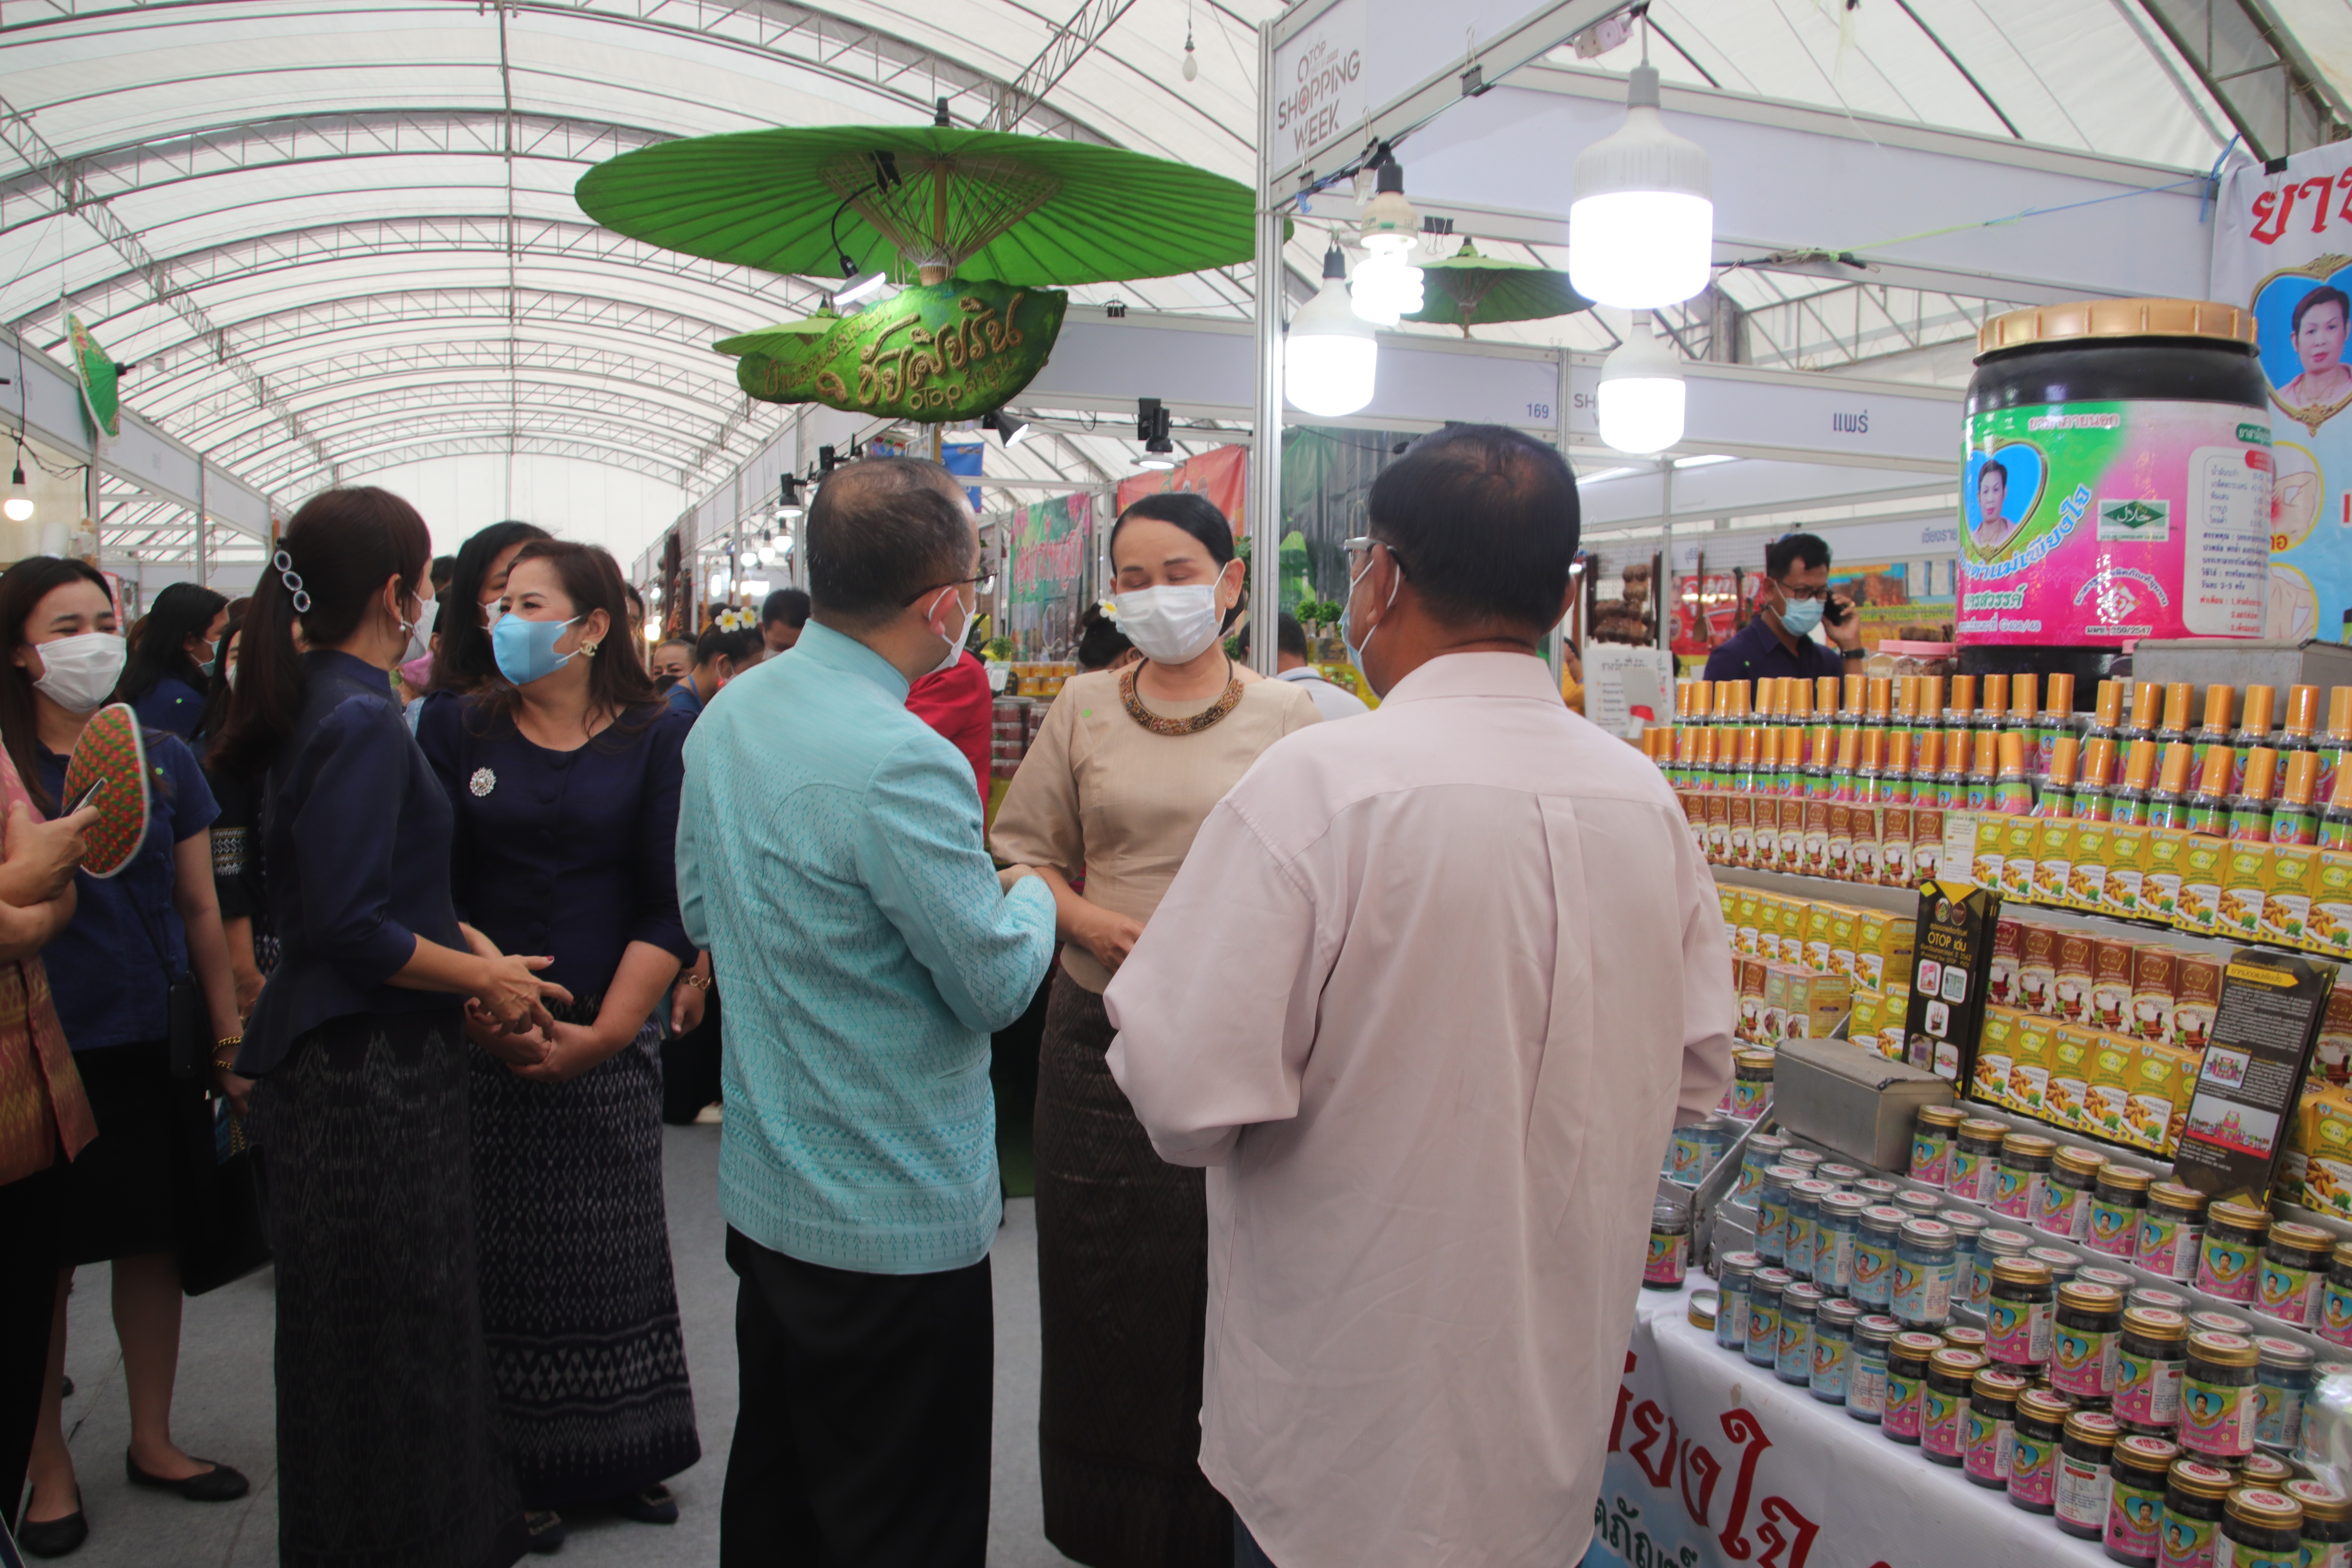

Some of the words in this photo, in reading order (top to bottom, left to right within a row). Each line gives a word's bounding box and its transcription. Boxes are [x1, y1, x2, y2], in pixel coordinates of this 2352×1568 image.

[1277, 48, 1361, 131] SHOPPING
[1294, 98, 1340, 156] WEEK
[909, 384, 962, 410] OTOP
[1527, 403, 1549, 419] 169
[1833, 410, 1869, 433] แพร่
[1964, 584, 2026, 609] นครสวรรค์
[1928, 931, 1952, 947] OTOP
[1953, 938, 1967, 952] เด่น
